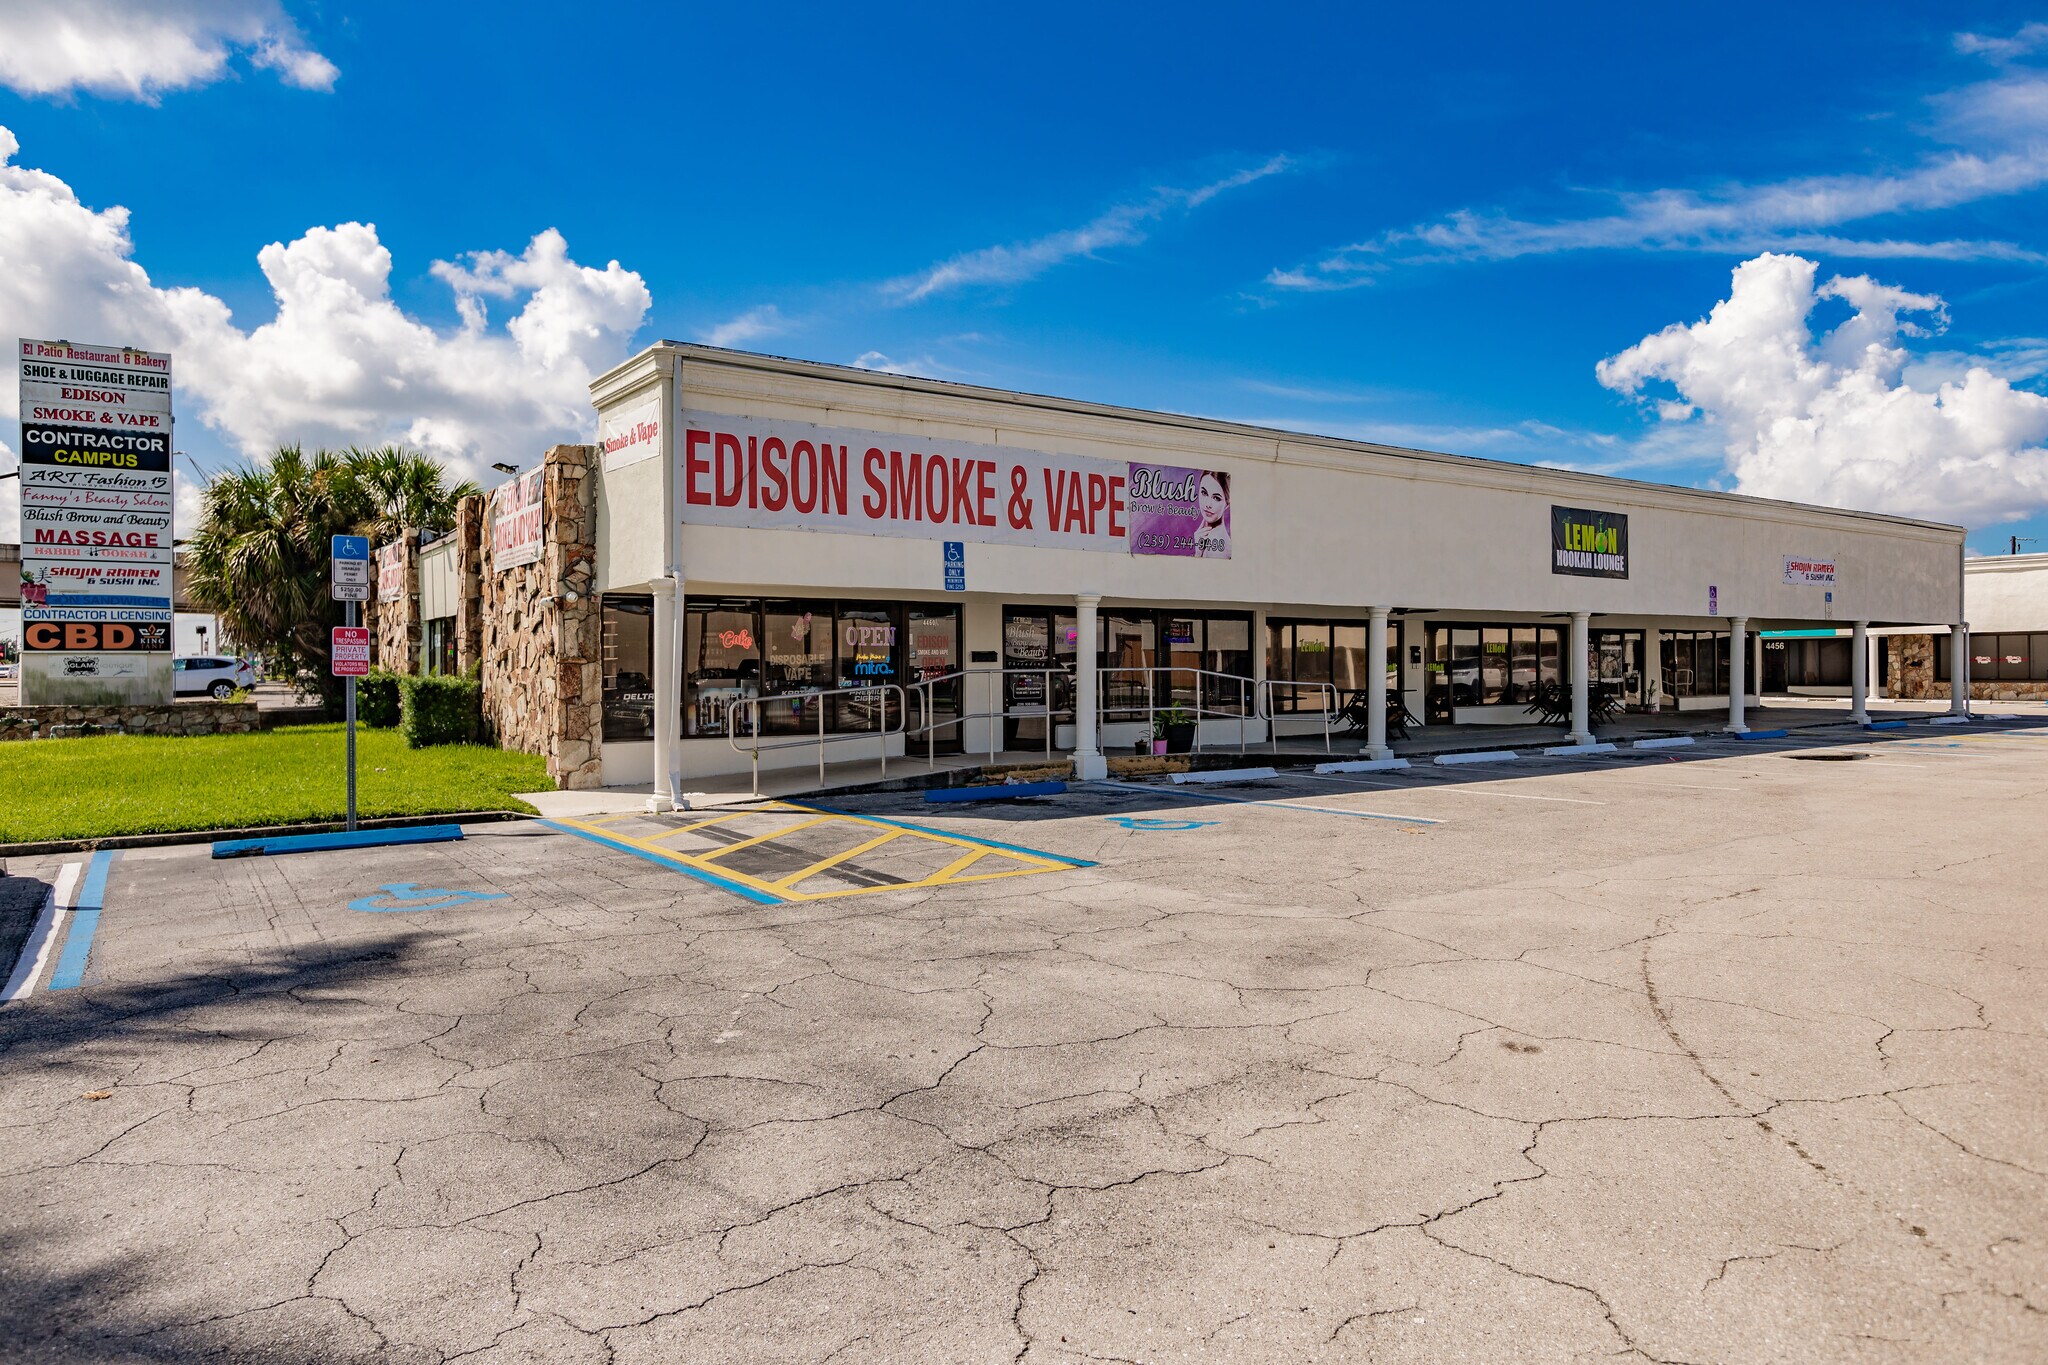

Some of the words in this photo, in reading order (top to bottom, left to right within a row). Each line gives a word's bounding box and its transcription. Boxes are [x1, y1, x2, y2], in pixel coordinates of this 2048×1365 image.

[23, 343, 33, 355] El
[37, 344, 63, 358] Patio
[66, 347, 120, 364] Restaurant
[124, 353, 131, 364] &
[134, 354, 168, 371] Bakery
[23, 364, 56, 378] SHOE
[59, 369, 68, 379] &
[71, 368, 124, 385] LUGGAGE
[127, 375, 168, 389] REPAIR
[61, 387, 126, 405] EDISON
[33, 407, 96, 423] SMOKE
[100, 412, 113, 424] &
[117, 413, 160, 427] VAPE
[26, 429, 164, 452] CONTRACTOR
[605, 432, 628, 454] Smoke
[630, 427, 636, 446] &
[637, 421, 658, 445] Vape
[54, 449, 138, 467] CAMPUS
[29, 470, 82, 484] ART
[84, 472, 147, 488] Fashion
[150, 476, 168, 489] 15
[686, 429, 848, 515] EDISON
[862, 448, 996, 527] SMOKE
[1008, 465, 1033, 531] &
[1043, 467, 1126, 537] VAPE
[1131, 467, 1198, 502] Blush
[22, 487, 80, 506] Fanny's
[85, 490, 129, 509] Beauty
[135, 493, 168, 507] Salon
[24, 508, 64, 522] Blush
[66, 511, 101, 523] Brow
[103, 514, 124, 525] and
[126, 514, 170, 530] Beauty
[1131, 500, 1155, 513] Brow
[1167, 503, 1200, 520] Beauty
[35, 528, 159, 547] MASSAGE
[1137, 532, 1171, 550] (239)
[1565, 522, 1617, 555] LEMON
[34, 547, 81, 556] HABIBI
[1556, 549, 1592, 569] HOOKAH
[1594, 553, 1625, 572] LOUNGE
[50, 567, 102, 579] SHOJIN
[105, 568, 160, 578] RAMEN
[944, 561, 964, 569] PARKING
[948, 569, 961, 577] ONLY
[87, 577, 96, 585] &
[99, 578, 135, 586] SUSHI
[138, 578, 160, 587] INC.
[24, 609, 107, 621] CONTRACTOR
[110, 610, 172, 621] LICENSING
[26, 623, 135, 649] CBD
[140, 637, 165, 645] KING
[335, 637, 367, 645] TRESPASSING
[344, 630, 358, 638] NO
[846, 626, 896, 647] OPEN
[917, 634, 949, 649] EDISON
[1018, 647, 1046, 660] Beauty
[1486, 643, 1506, 654] LEMON
[1765, 642, 1785, 650] 4456
[69, 661, 94, 669] GLAM
[769, 653, 825, 666] DISPOSABLE
[1427, 662, 1445, 672] LEMON
[784, 667, 812, 681] VAPE
